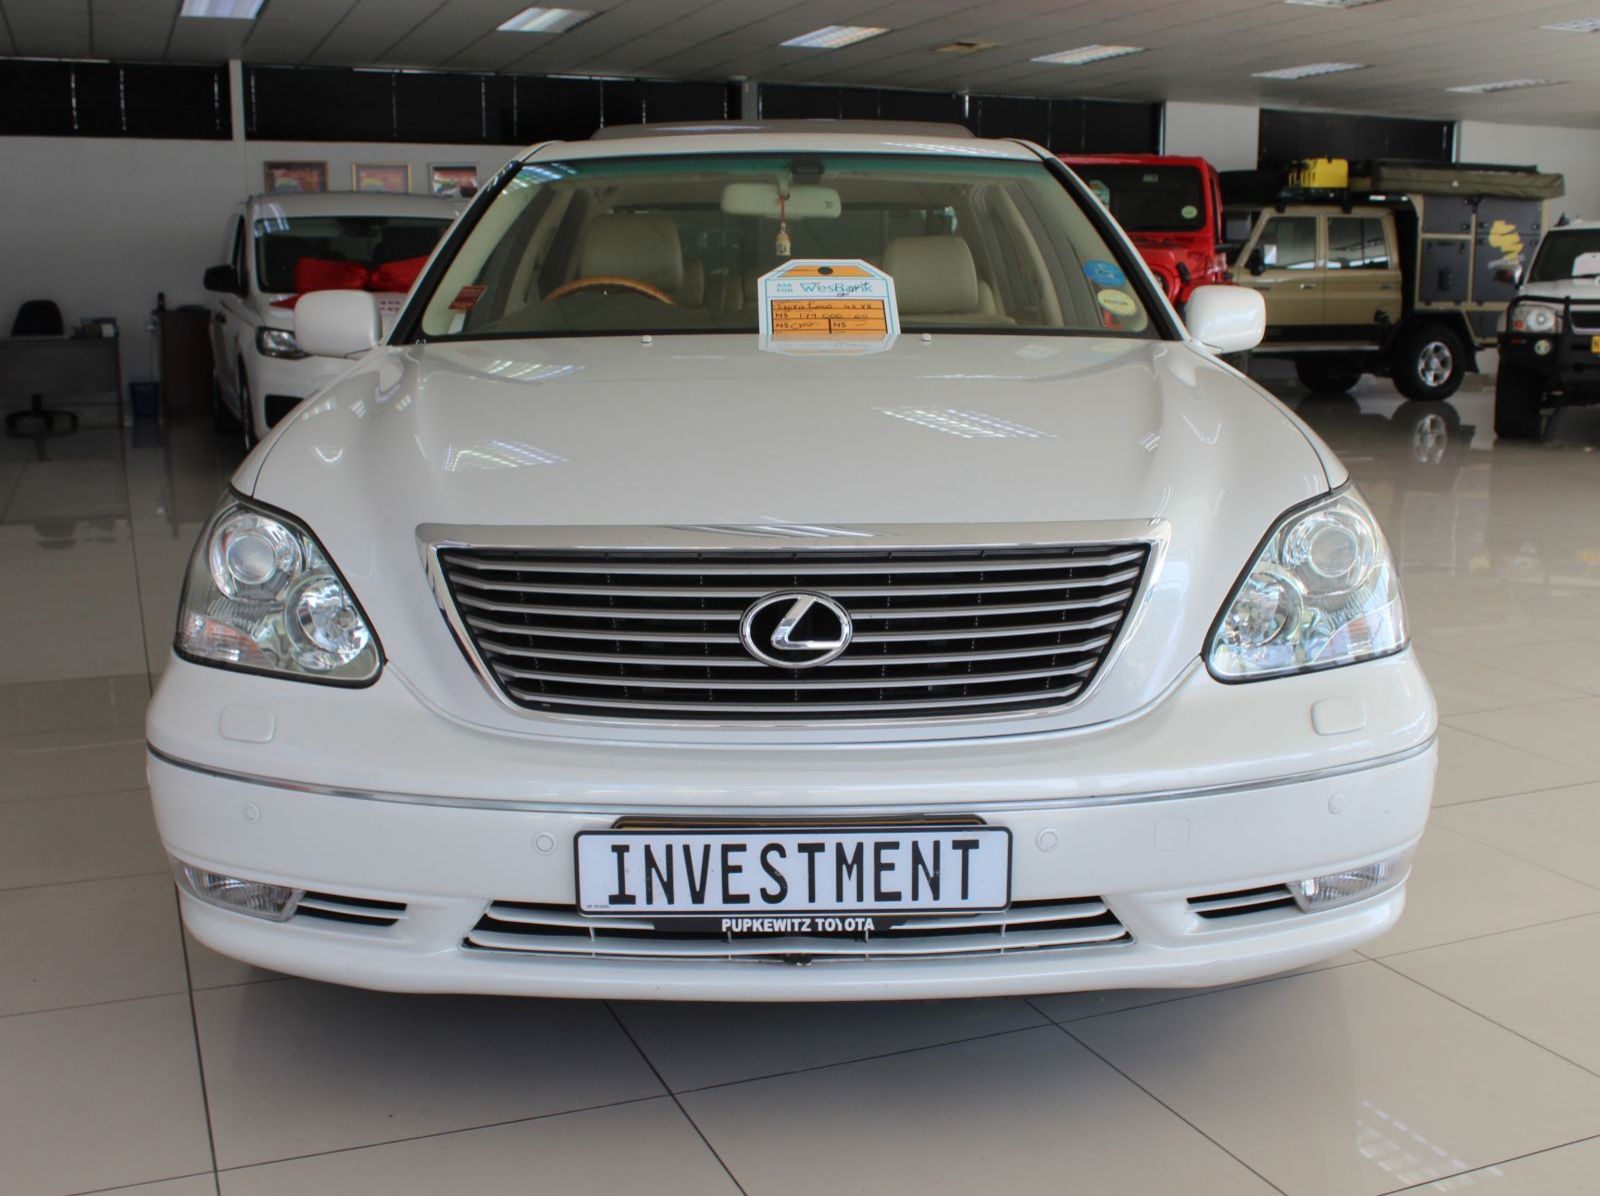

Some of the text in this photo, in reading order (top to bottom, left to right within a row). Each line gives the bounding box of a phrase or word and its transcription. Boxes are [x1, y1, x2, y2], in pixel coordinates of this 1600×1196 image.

[608, 839, 981, 906] INVESTMENT
[721, 917, 875, 933] PUPKEWITZ TOYOTA
